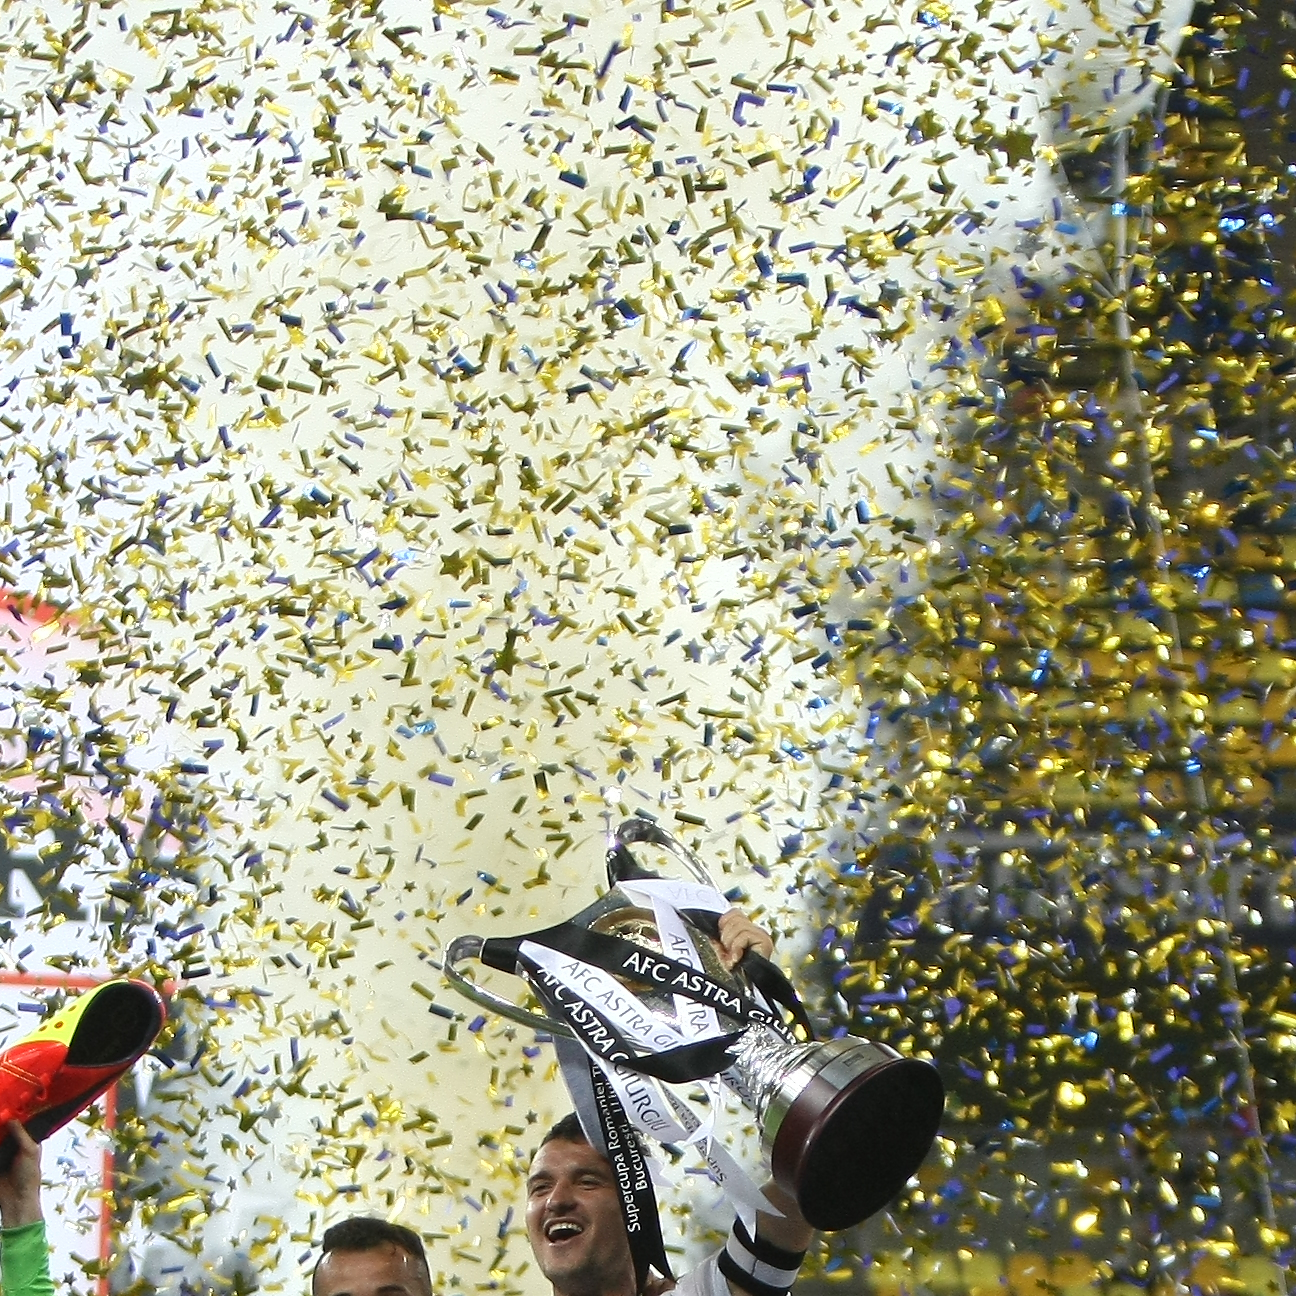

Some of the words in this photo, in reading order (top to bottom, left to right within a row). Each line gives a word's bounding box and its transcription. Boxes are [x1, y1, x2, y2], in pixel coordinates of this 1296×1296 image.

[561, 961, 603, 993] AFC
[596, 989, 654, 1037] ASTRA
[622, 951, 671, 982] AFC
[671, 972, 743, 1014] ASTRA
[564, 1000, 617, 1053] ASTRA
[614, 1152, 641, 1234] Supercupa
